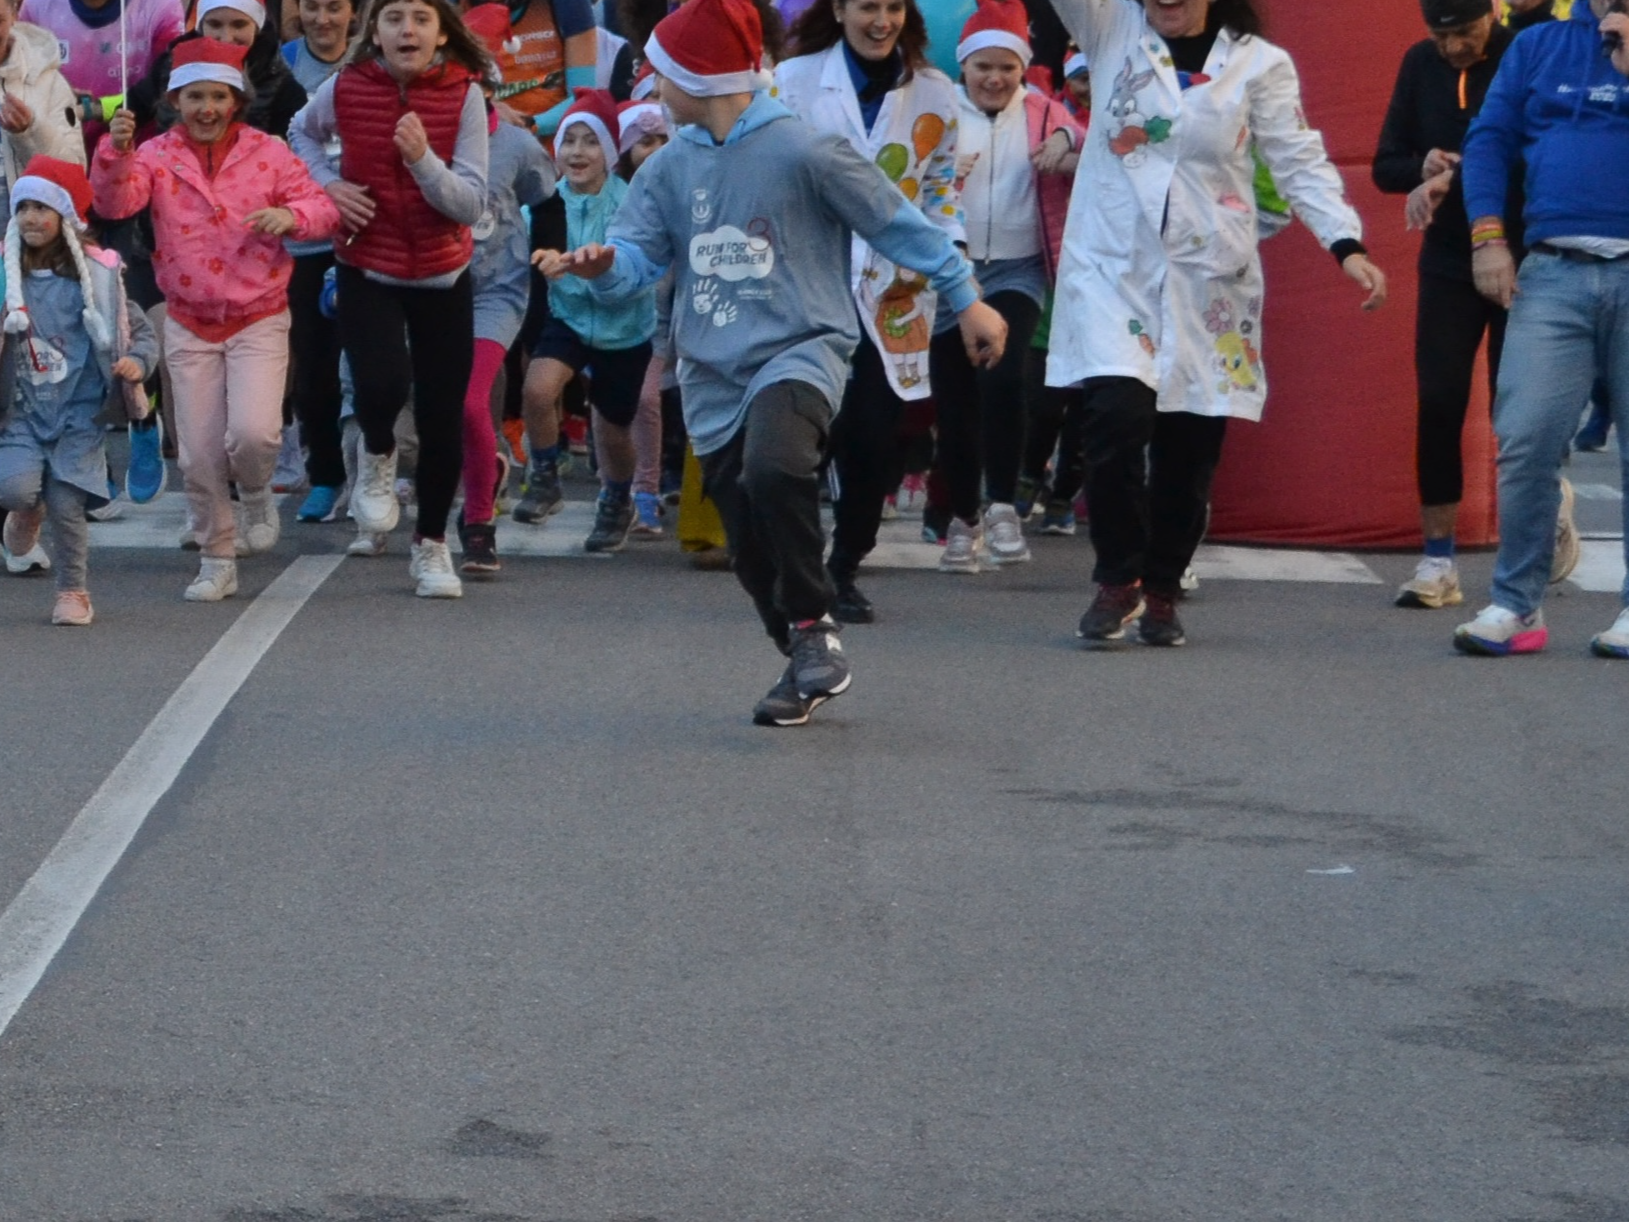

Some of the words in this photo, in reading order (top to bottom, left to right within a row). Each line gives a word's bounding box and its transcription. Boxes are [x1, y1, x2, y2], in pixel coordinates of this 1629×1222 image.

[696, 244, 724, 257] RUN
[726, 241, 748, 254] FOR
[710, 252, 767, 268] CHILDREN
